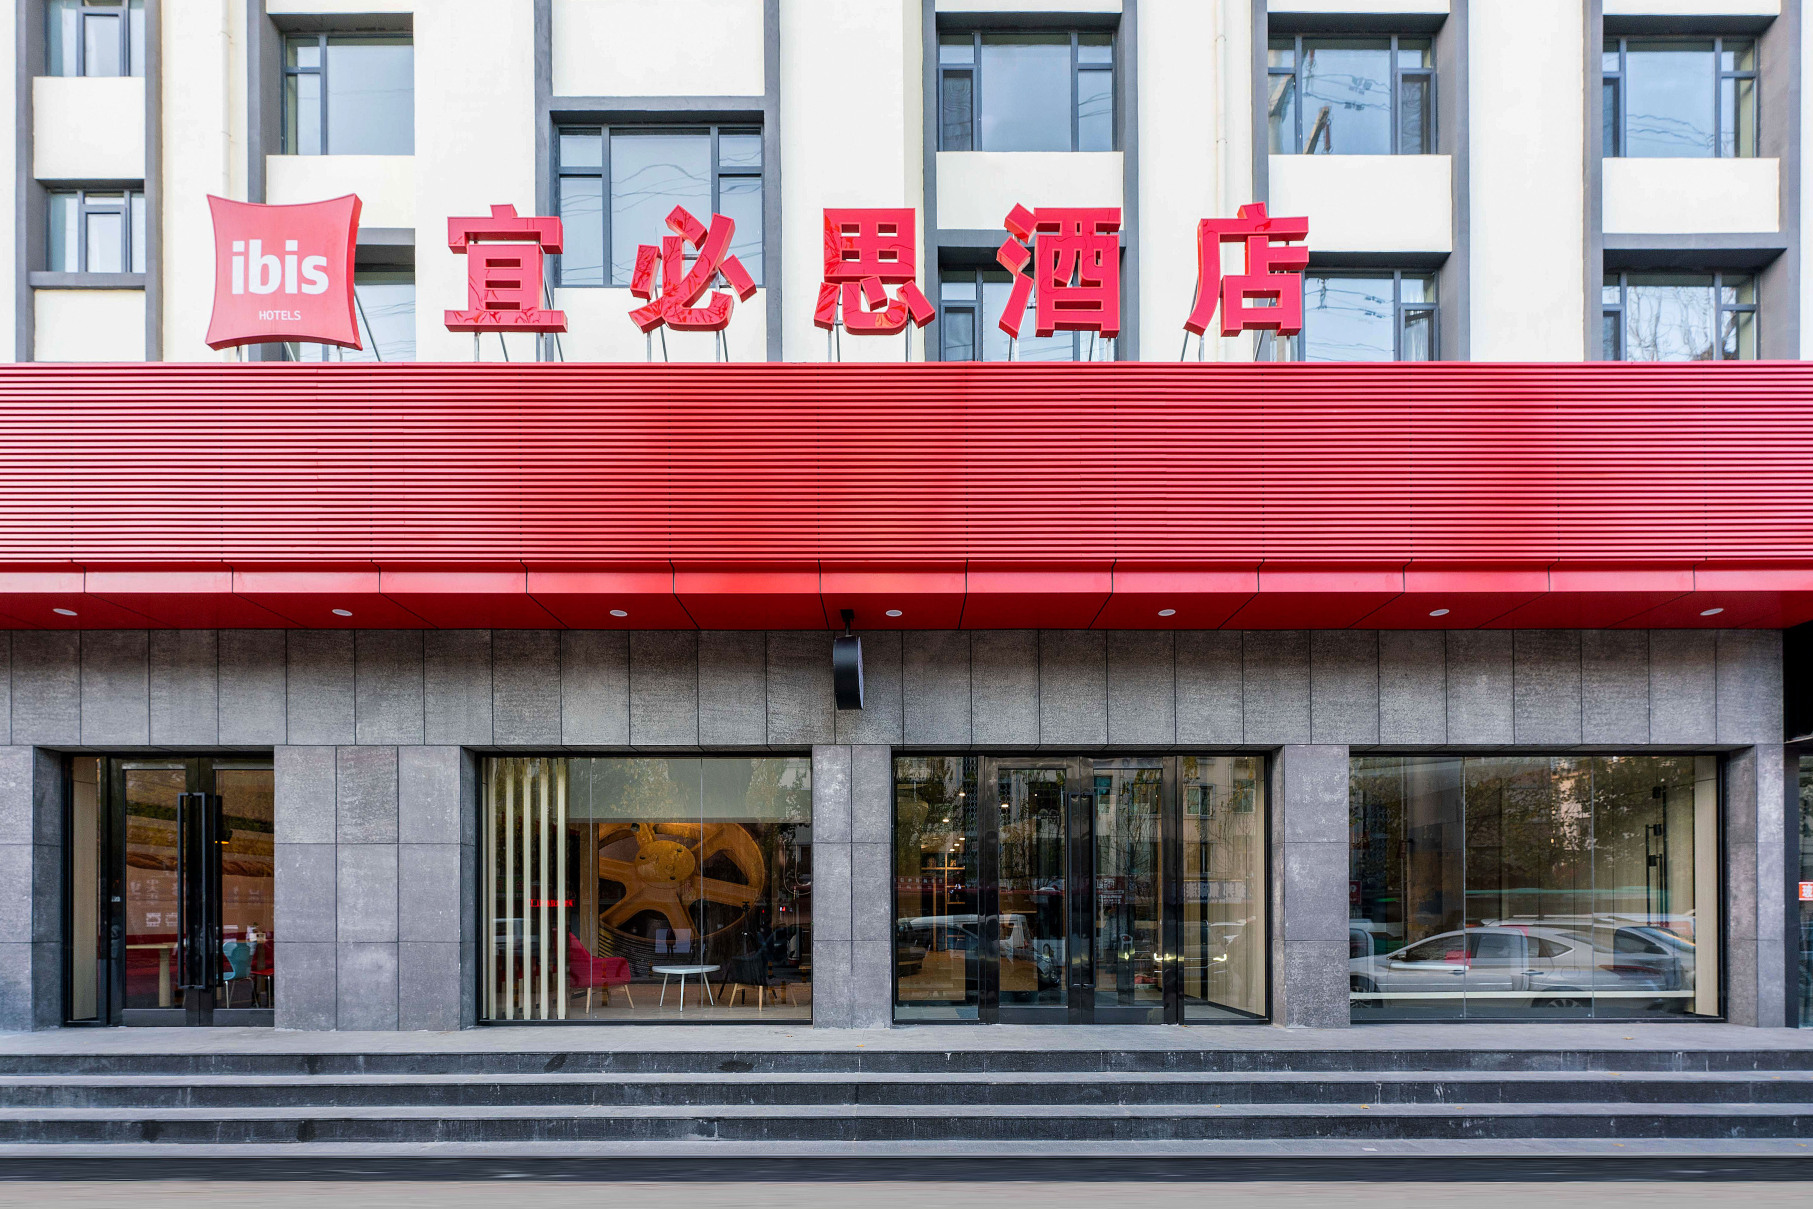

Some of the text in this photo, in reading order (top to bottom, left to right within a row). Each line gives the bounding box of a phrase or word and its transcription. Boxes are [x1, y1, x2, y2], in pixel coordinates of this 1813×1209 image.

[232, 239, 329, 295] ibis
[444, 203, 1310, 338] 宜必思酒店
[259, 310, 302, 321] HOTELS
